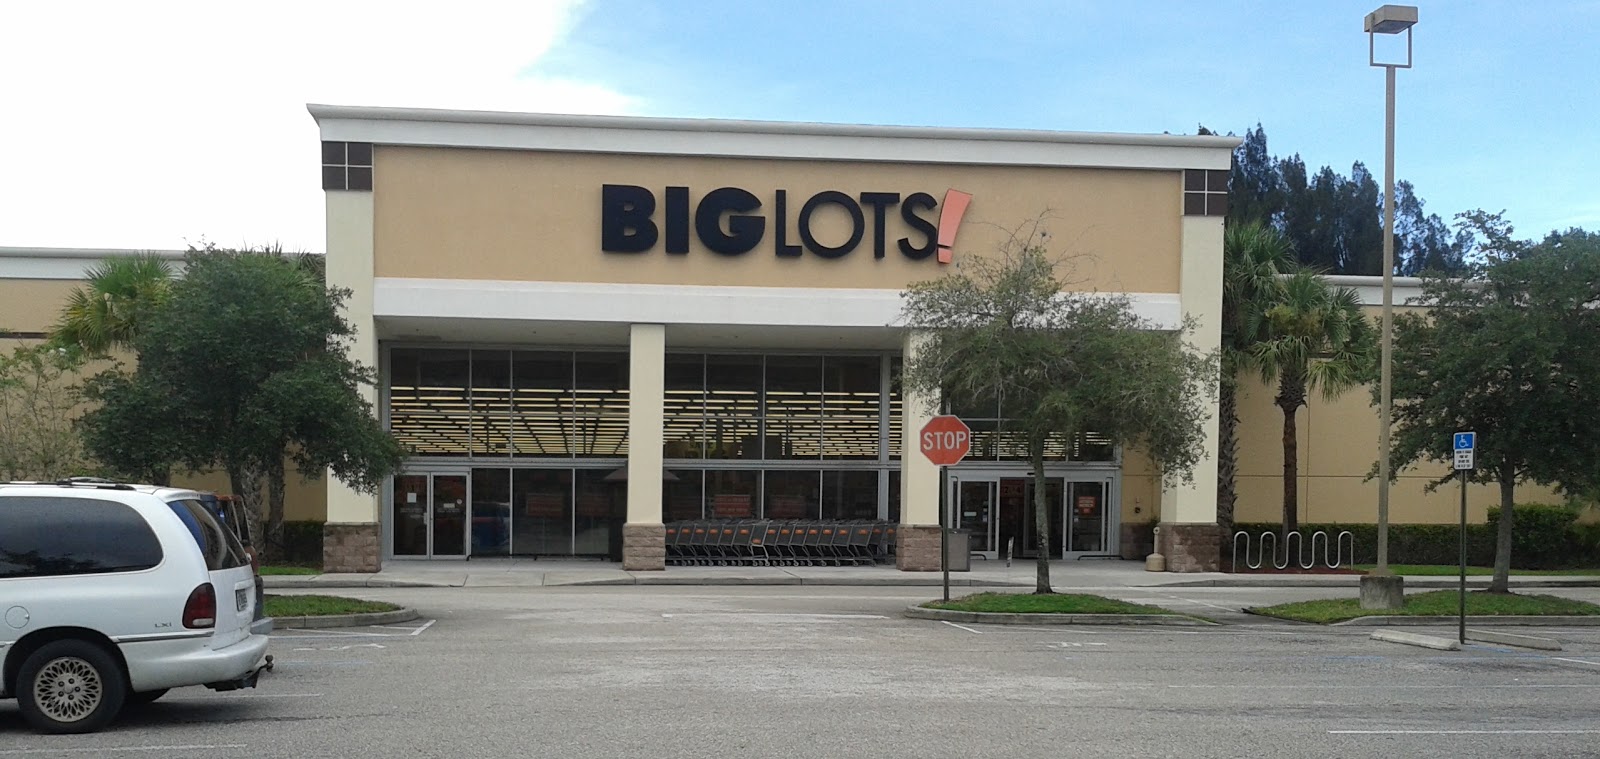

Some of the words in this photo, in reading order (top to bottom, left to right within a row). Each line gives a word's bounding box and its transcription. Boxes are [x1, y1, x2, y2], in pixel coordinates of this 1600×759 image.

[602, 184, 766, 256] BIG
[775, 188, 974, 264] LOTS!
[923, 431, 967, 450] STOP
